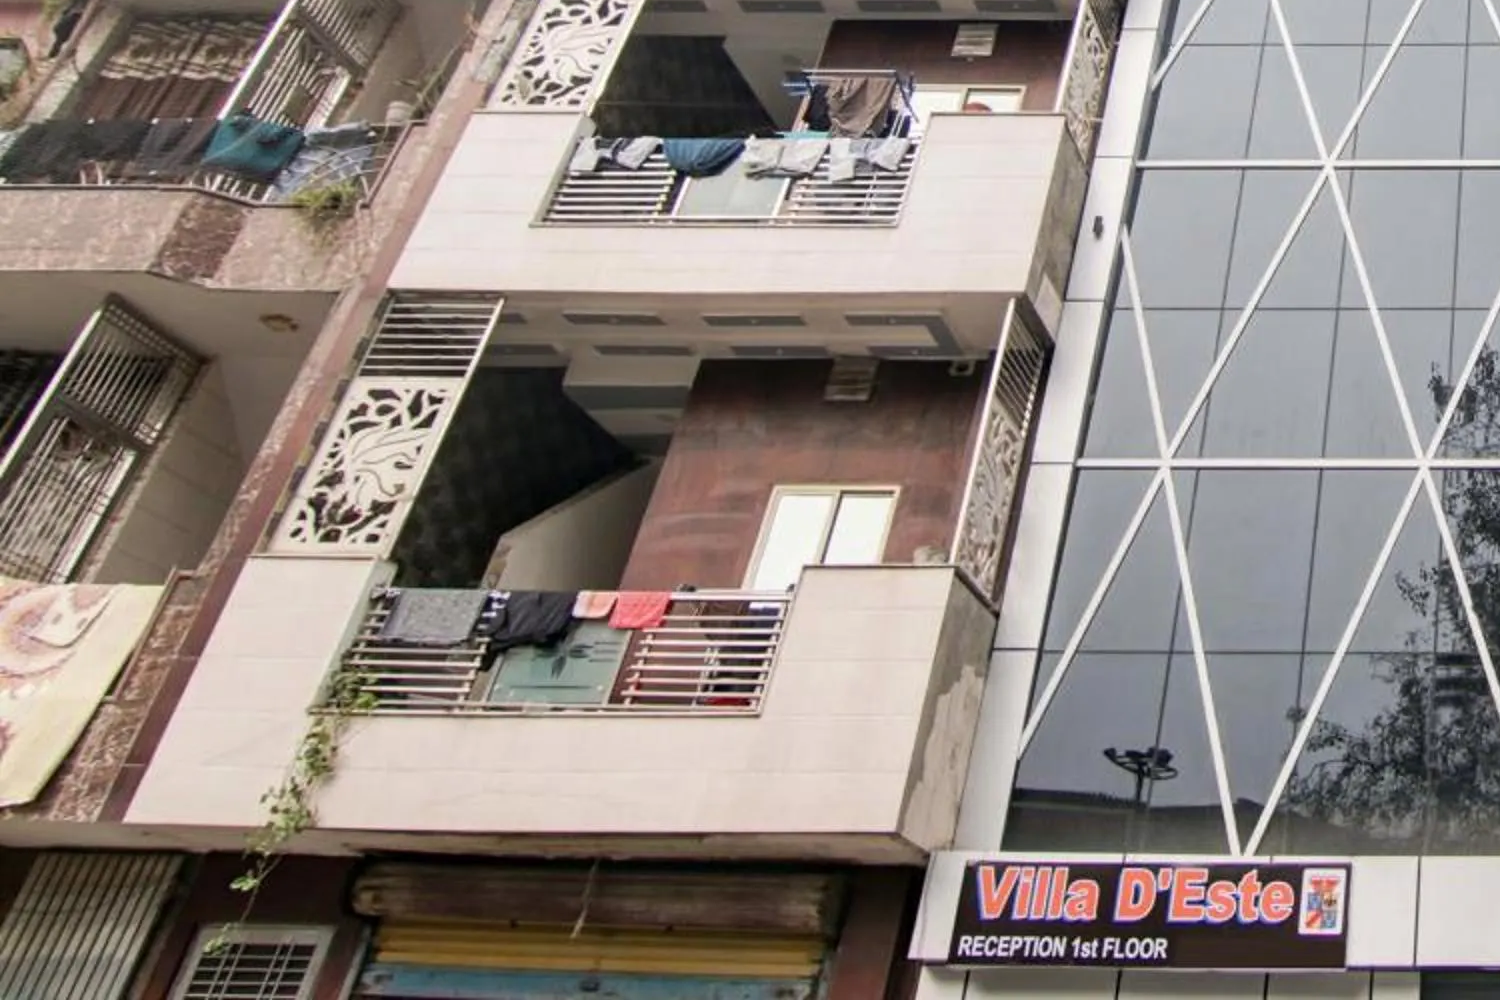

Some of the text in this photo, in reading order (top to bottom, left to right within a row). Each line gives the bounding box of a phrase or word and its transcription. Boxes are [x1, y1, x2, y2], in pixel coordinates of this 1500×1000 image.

[977, 866, 1295, 924] Villa D'Este
[957, 935, 1168, 960] RECEPTION 1st FLOOR
